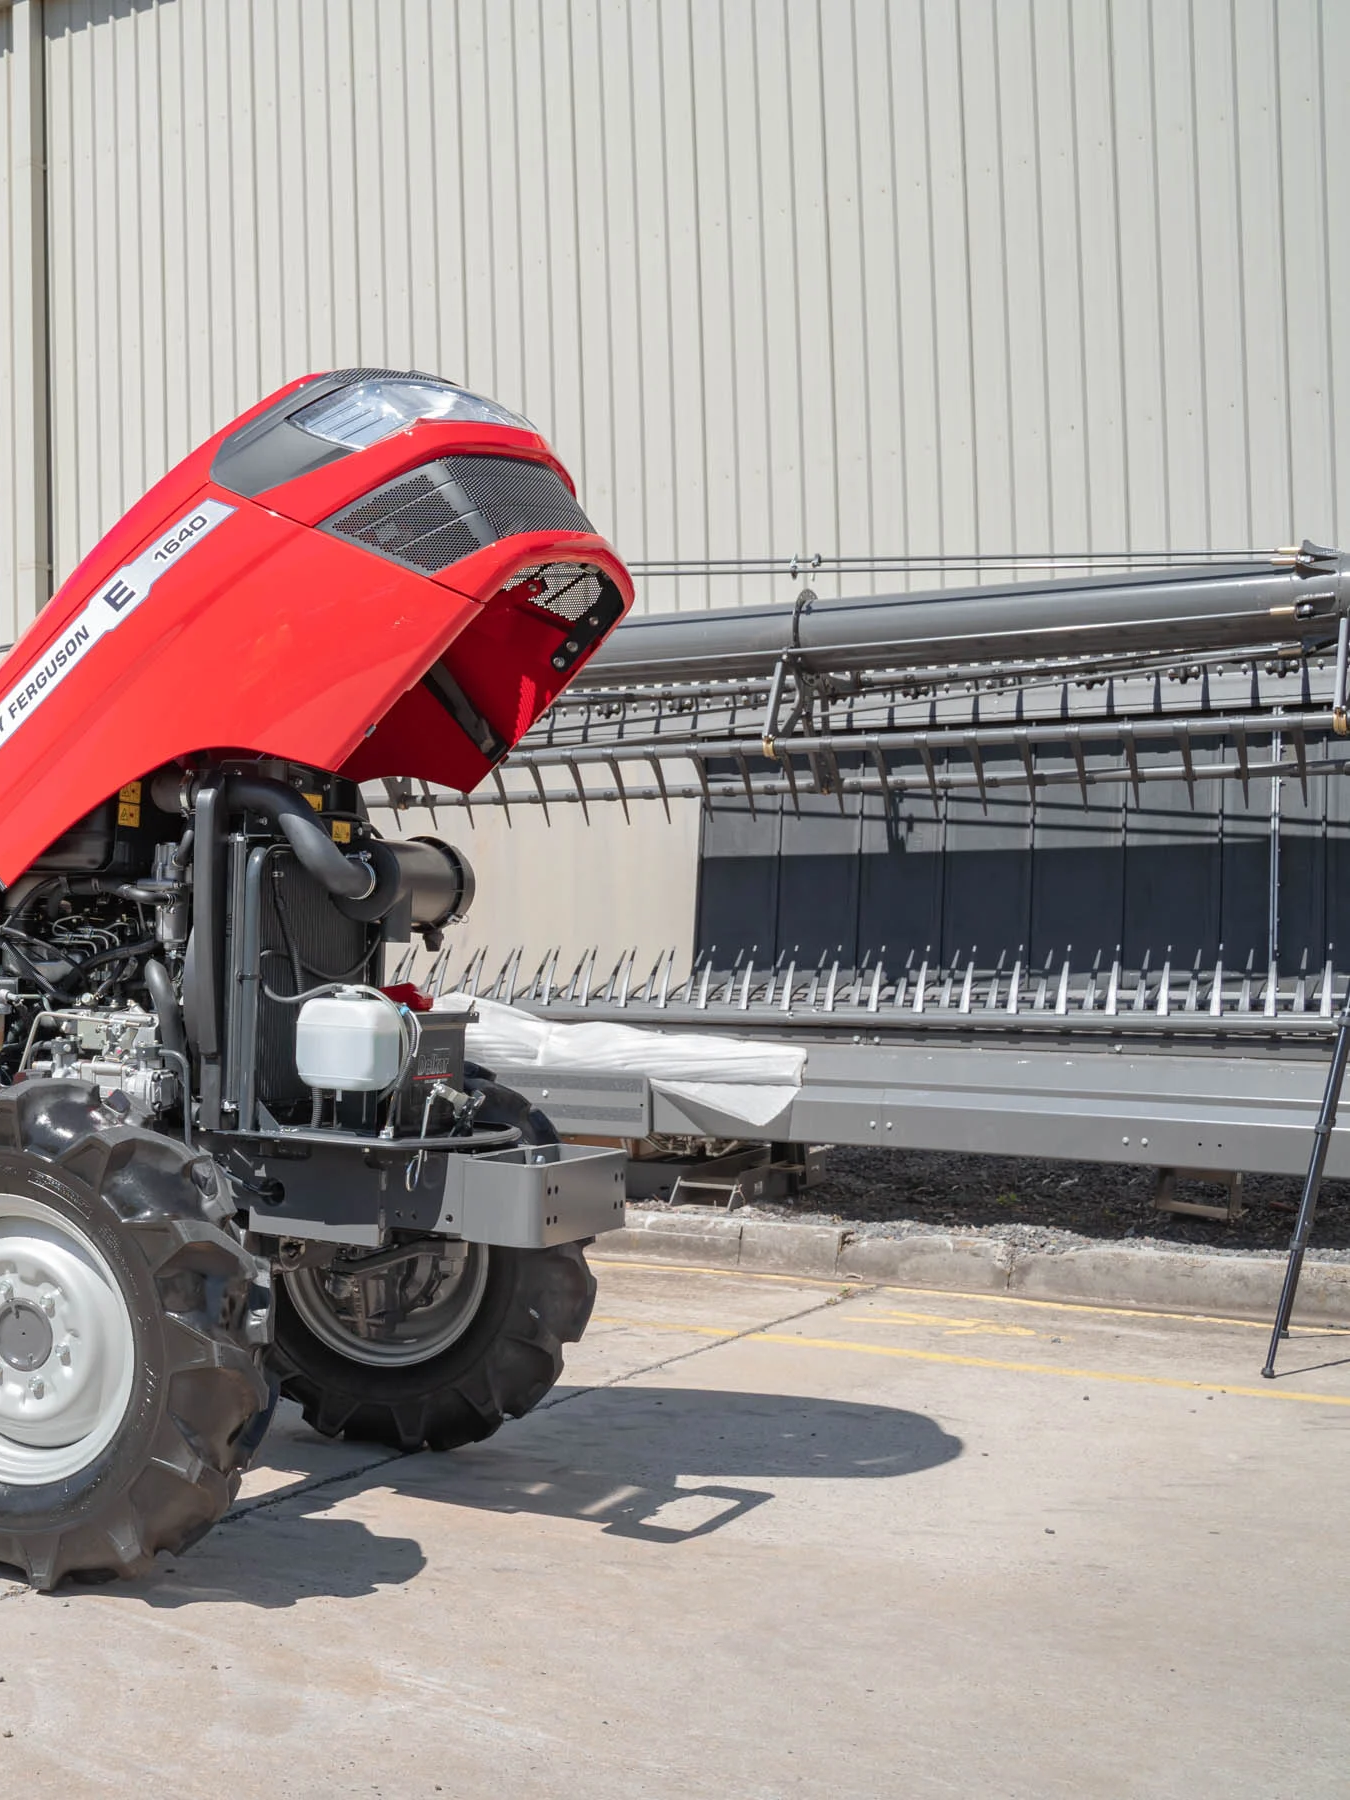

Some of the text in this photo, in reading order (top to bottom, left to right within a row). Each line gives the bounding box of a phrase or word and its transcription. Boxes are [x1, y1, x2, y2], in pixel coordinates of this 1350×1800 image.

[8, 625, 90, 720] FERGUSON
[103, 580, 136, 612] E
[153, 515, 208, 561] 1640
